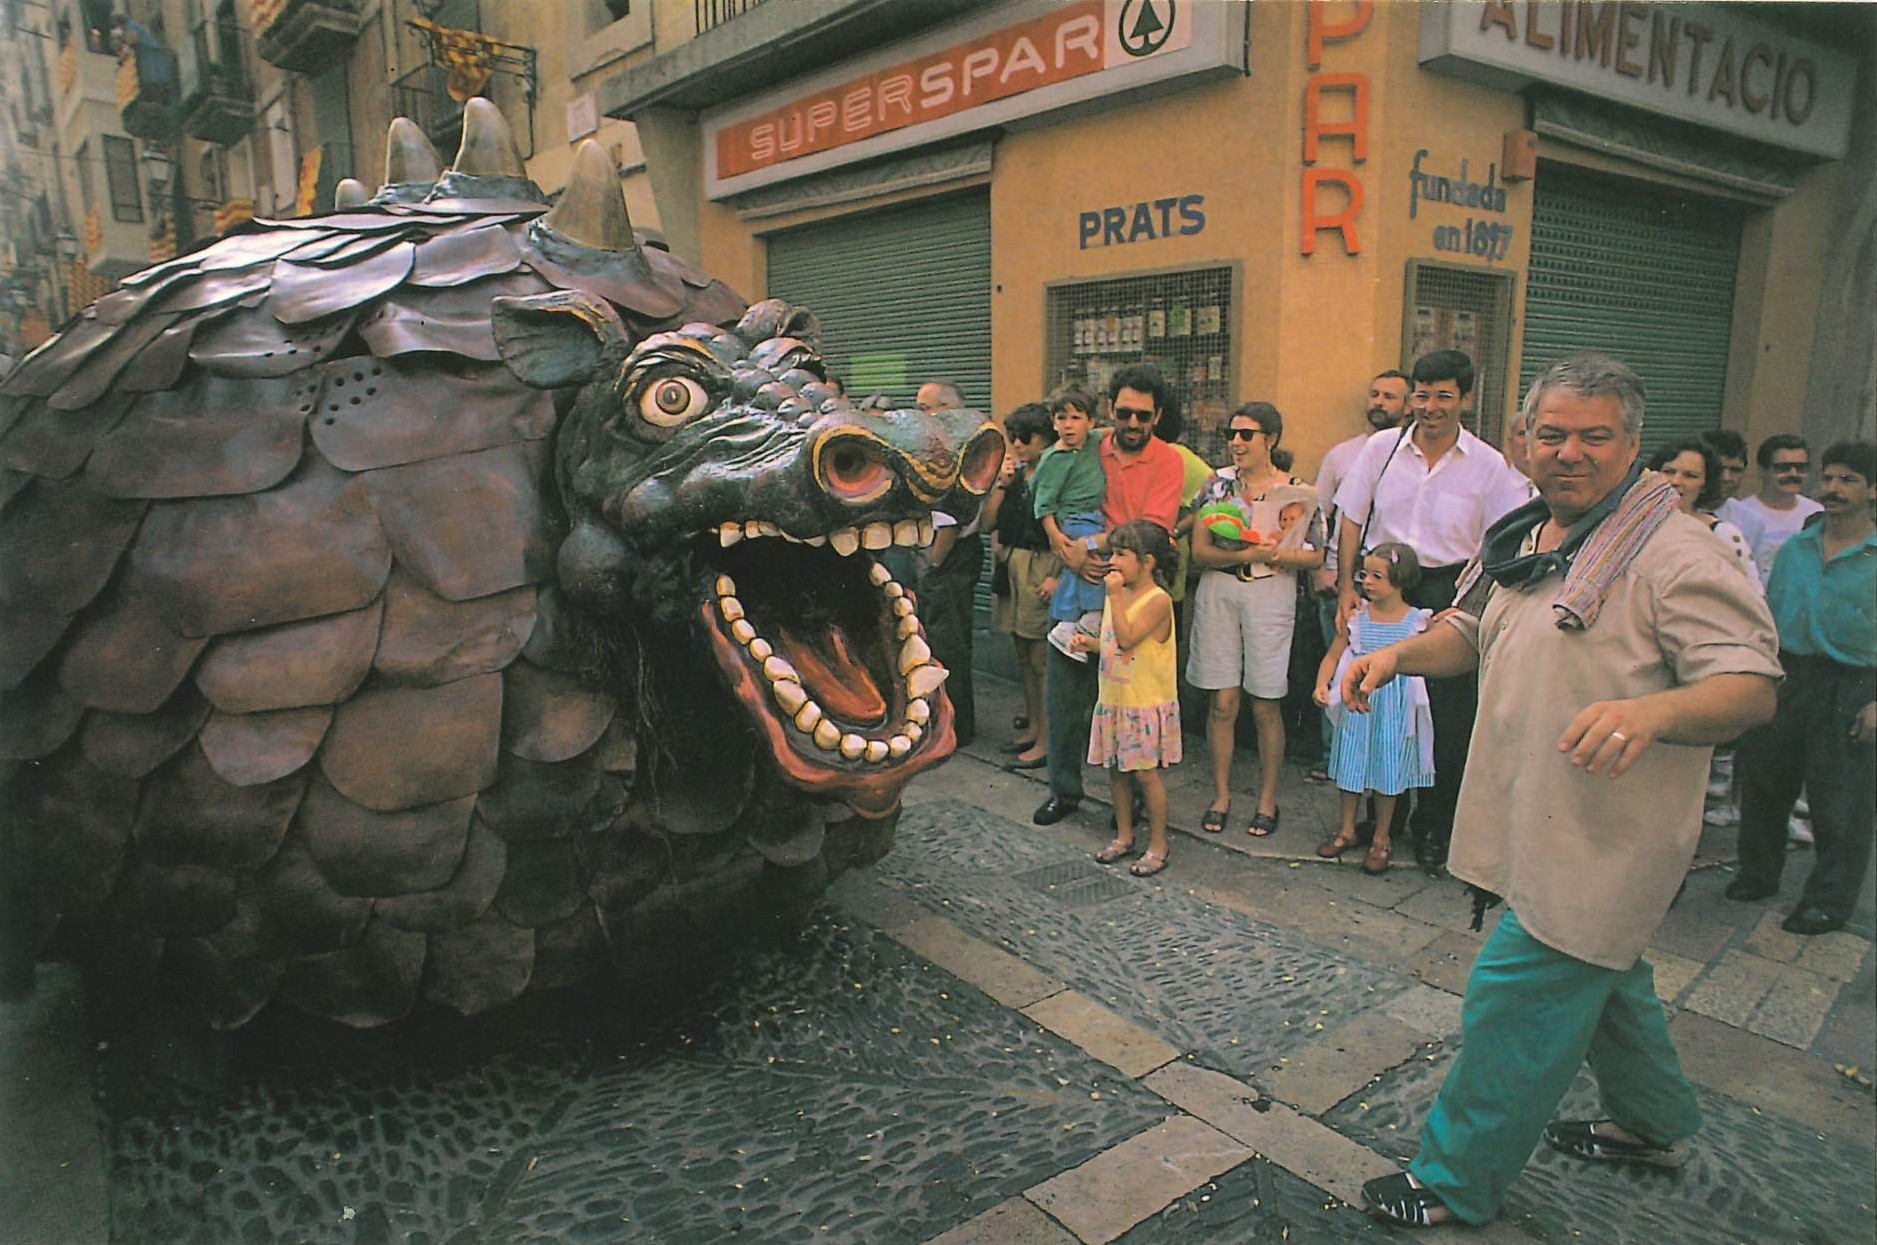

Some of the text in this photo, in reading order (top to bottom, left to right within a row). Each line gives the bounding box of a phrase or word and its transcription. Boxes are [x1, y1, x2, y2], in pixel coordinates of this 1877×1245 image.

[749, 13, 1099, 162] SUPERSPAR
[1409, 149, 1506, 220] fundada
[1079, 194, 1206, 250] PRATS
[1433, 225, 1460, 252] en
